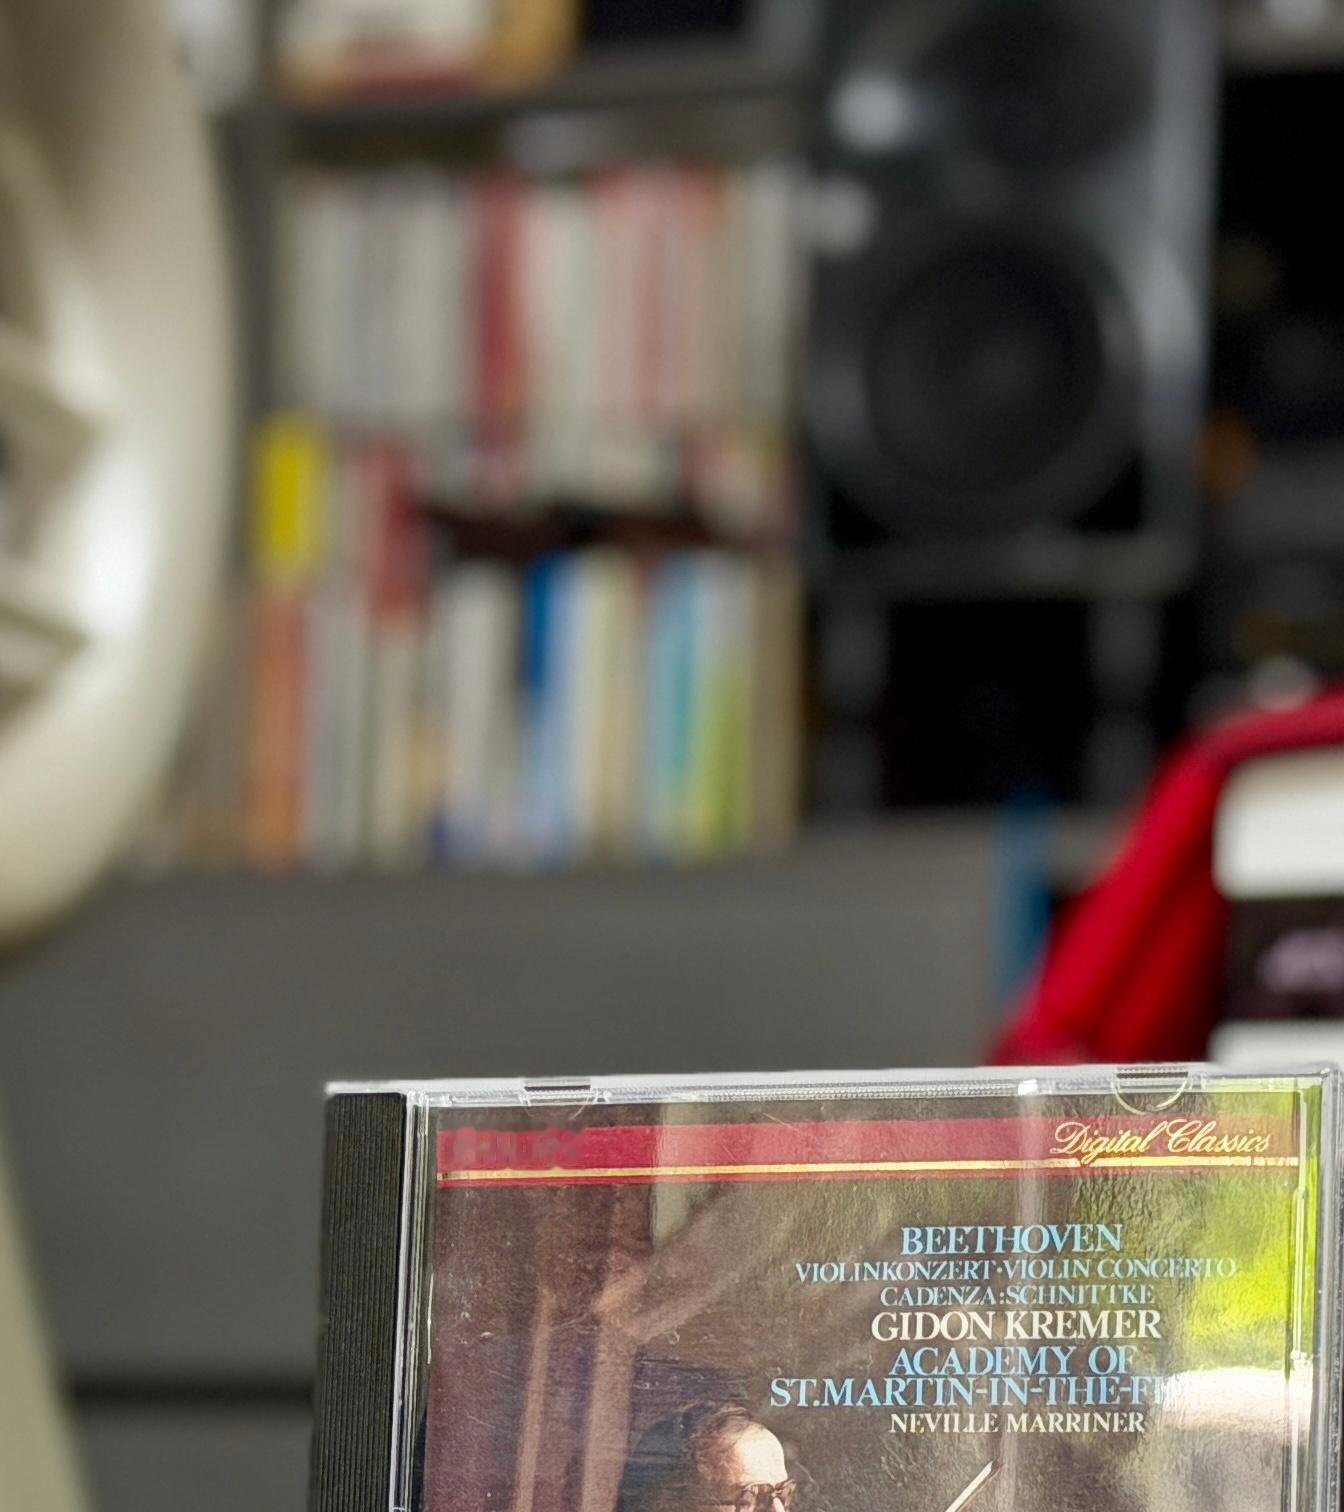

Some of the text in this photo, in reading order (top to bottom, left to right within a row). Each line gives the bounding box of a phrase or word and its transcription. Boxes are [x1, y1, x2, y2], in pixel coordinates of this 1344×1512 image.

[1050, 1118, 1270, 1164] Digital Classics
[900, 1223, 1123, 1255] BEETHOVEN
[1096, 1257, 1237, 1280] CONCERTO
[871, 1309, 1162, 1341] GIDON KREMER
[888, 1344, 1138, 1376] ACADEMY OF
[888, 1411, 1146, 1433] NEVILLE MARRINER
